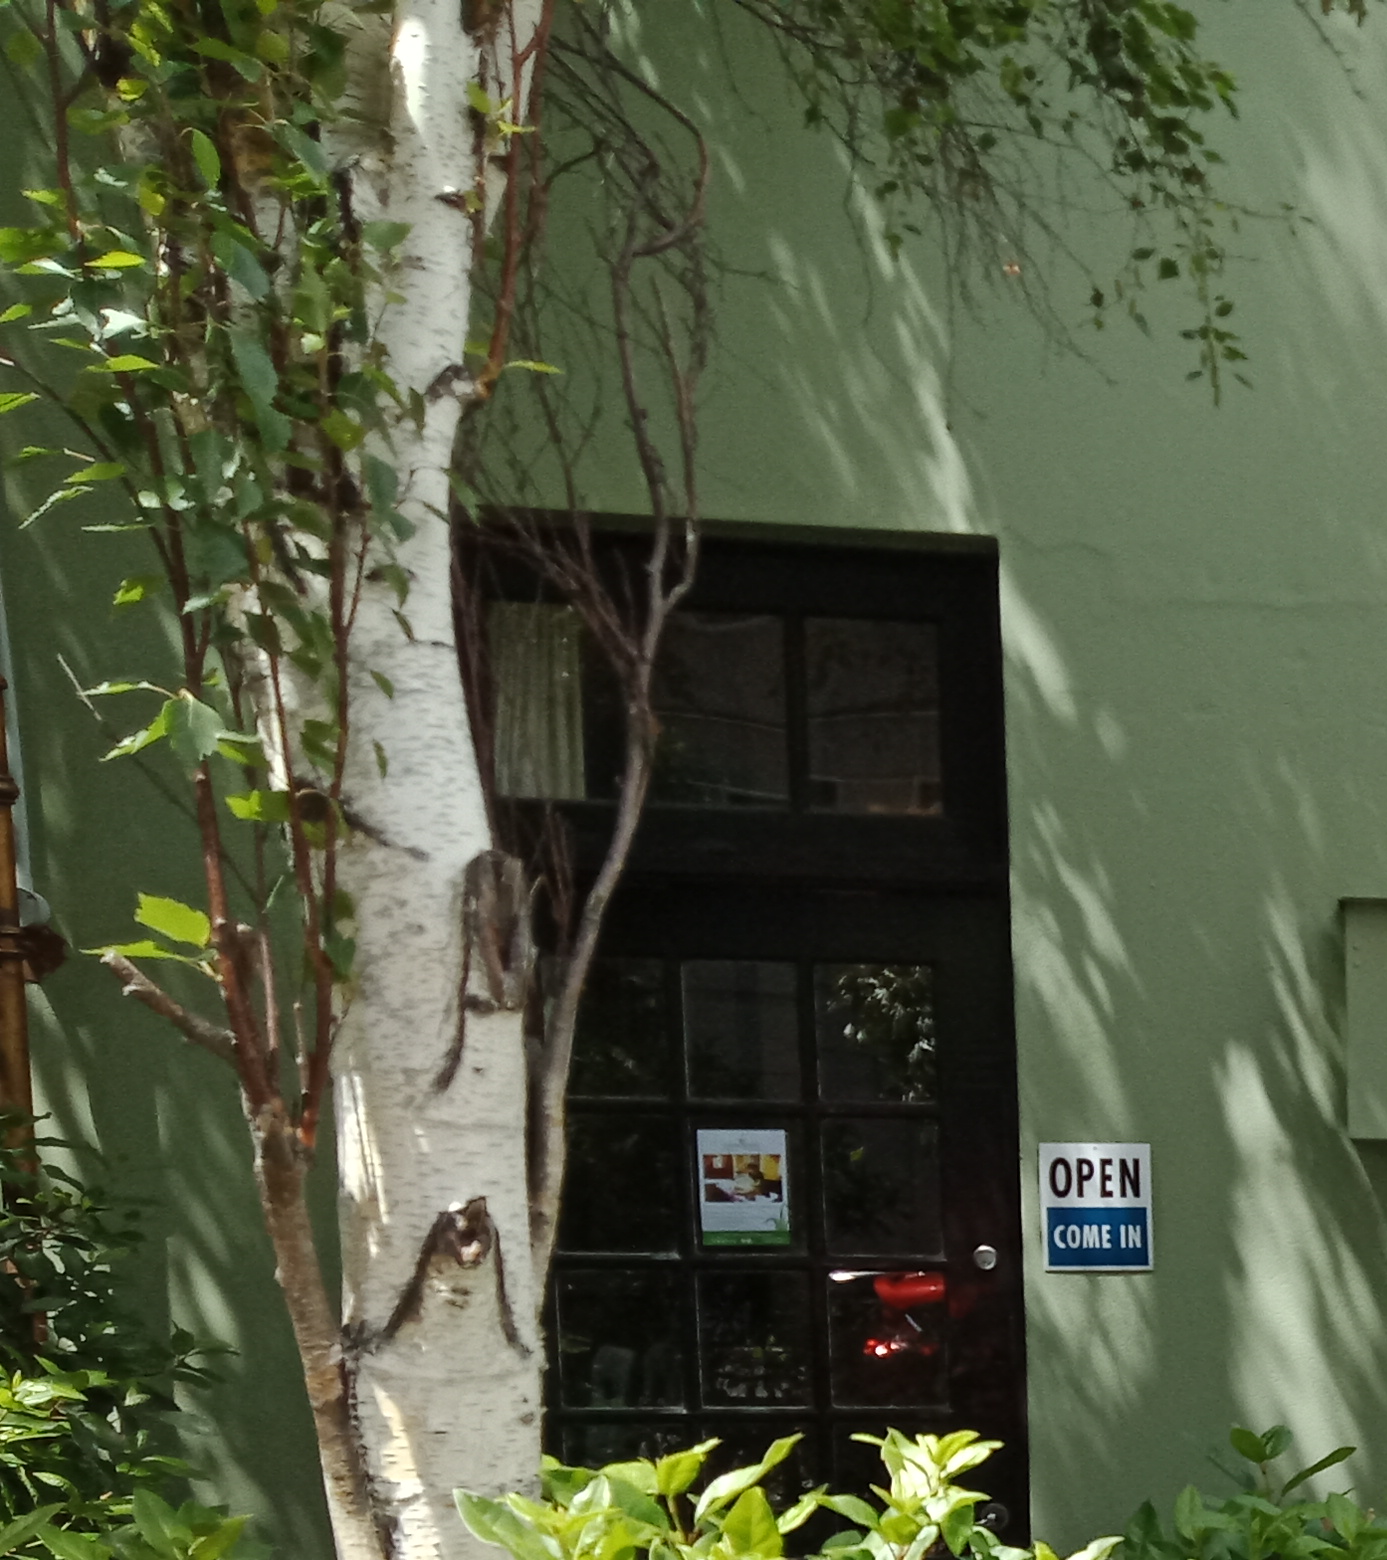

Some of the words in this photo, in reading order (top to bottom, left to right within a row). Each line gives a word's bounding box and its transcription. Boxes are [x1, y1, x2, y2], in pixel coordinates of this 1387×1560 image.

[1048, 1157, 1141, 1198] OPEN
[1053, 1224, 1112, 1249] COME
[1119, 1224, 1141, 1249] IN
